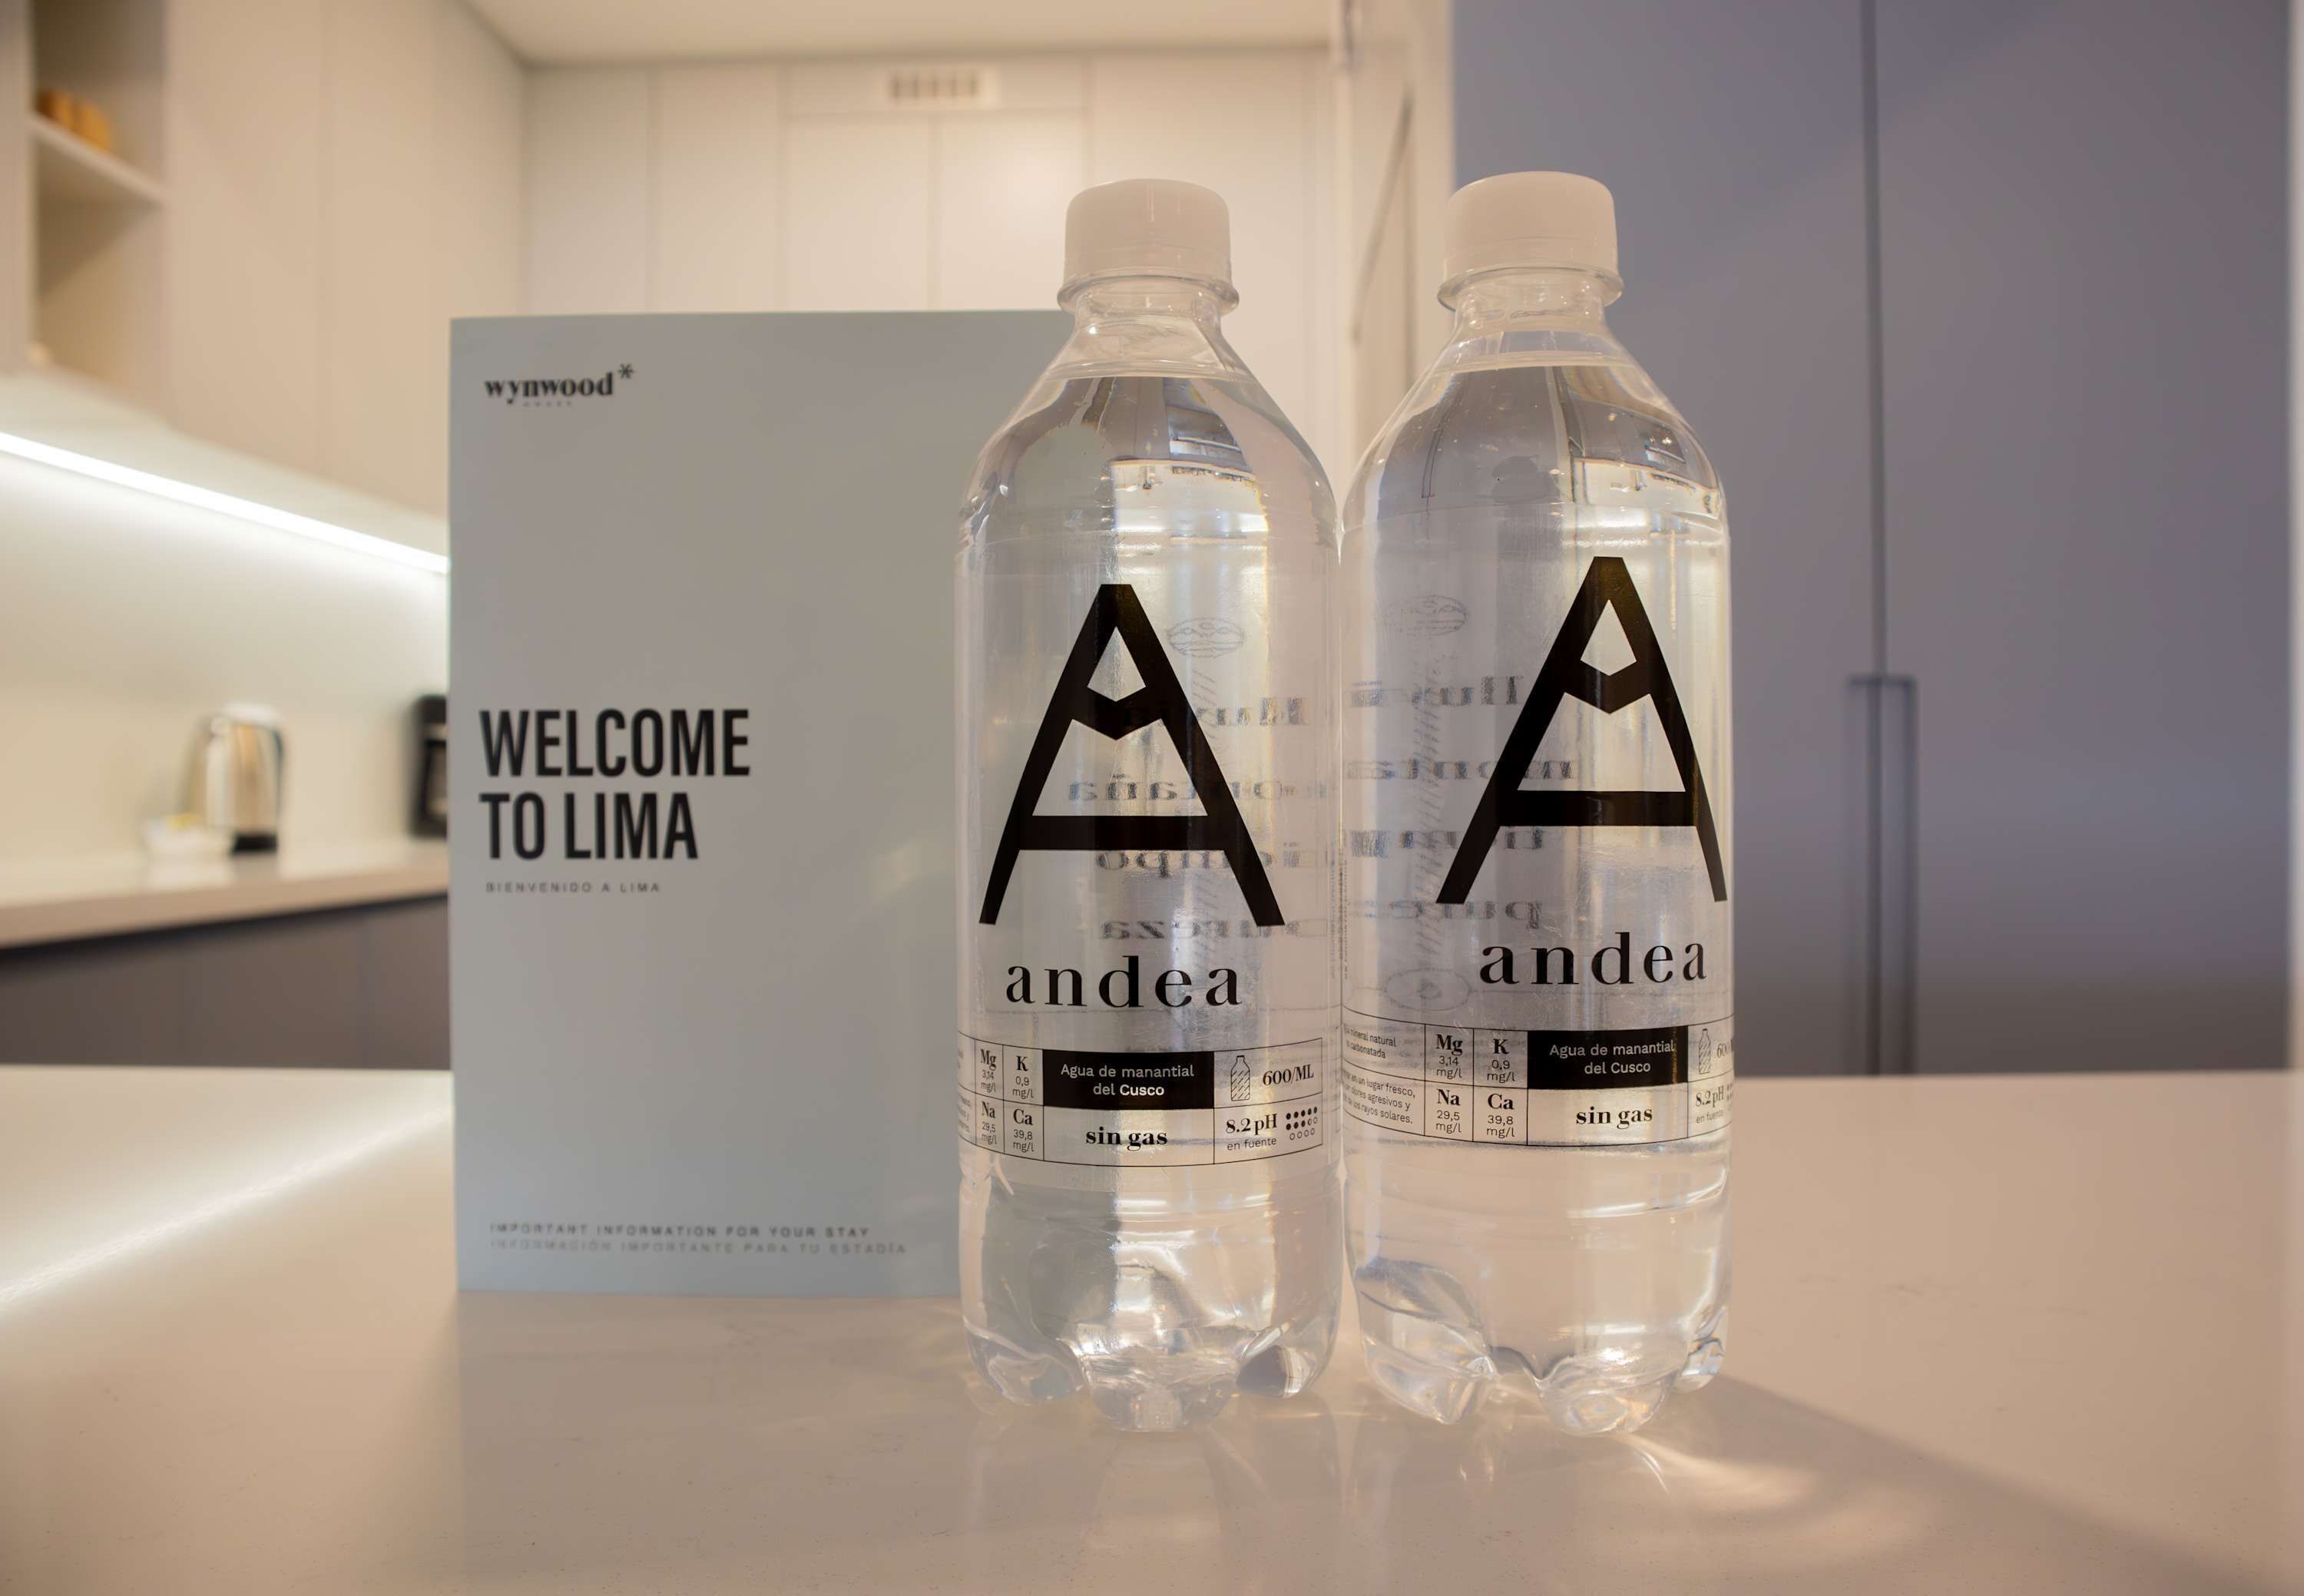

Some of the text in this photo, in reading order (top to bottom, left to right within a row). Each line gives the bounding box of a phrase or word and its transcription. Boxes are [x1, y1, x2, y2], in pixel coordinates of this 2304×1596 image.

[484, 372, 613, 404] wynwood
[479, 709, 750, 777] WELCOME
[479, 792, 698, 860] TO LIMA
[485, 882, 659, 893] BIENVENIDO A LIMA
[1480, 932, 1706, 985] andea
[1006, 955, 1243, 1008] andea
[1369, 1035, 1397, 1047] natural
[1436, 1035, 1463, 1055] Mg
[1492, 1038, 1509, 1055] K
[1549, 1040, 1675, 1059] Agua de manantial
[981, 1049, 997, 1071] Mg
[1016, 1055, 1029, 1071] K
[1438, 1056, 1459, 1066] 3,14
[1491, 1060, 1510, 1070] 0,9
[1061, 1064, 1195, 1078] Agua de manantial
[1436, 1068, 1462, 1079] mg/l
[1584, 1062, 1651, 1074] del Cusco
[1015, 1076, 1030, 1086] 0,9
[1263, 1064, 1315, 1087] 600/ML
[1487, 1072, 1516, 1084] mg/l
[981, 1081, 996, 1093] mg/l
[1012, 1088, 1034, 1100] mg/l
[1093, 1083, 1165, 1097] del Cusco
[1385, 1082, 1415, 1099] fresco,
[1367, 1093, 1402, 1108] agresivos
[1405, 1102, 1411, 1112] y
[1437, 1089, 1461, 1106] Na
[1488, 1094, 1514, 1110] Ca
[982, 1101, 996, 1119] Na
[1013, 1108, 1034, 1126] Ca
[1361, 1104, 1379, 1116] rayos
[1380, 1110, 1413, 1124] solares.
[1437, 1111, 1460, 1121] 29,5
[1487, 1115, 1514, 1125] 39,8
[1575, 1106, 1653, 1129] sin gas
[1696, 1115, 1705, 1124] en
[982, 1121, 996, 1134] 29,5
[1435, 1123, 1462, 1134] mg/l
[1486, 1127, 1515, 1138] mg/l
[1013, 1129, 1033, 1141] 39,8
[1085, 1127, 1168, 1151] sin gas
[1012, 1143, 1034, 1153] mg/l
[1226, 1137, 1277, 1151] en fuente
[490, 1223, 869, 1238] IMPORTANT INFORMATION FOR YOUR STAY
